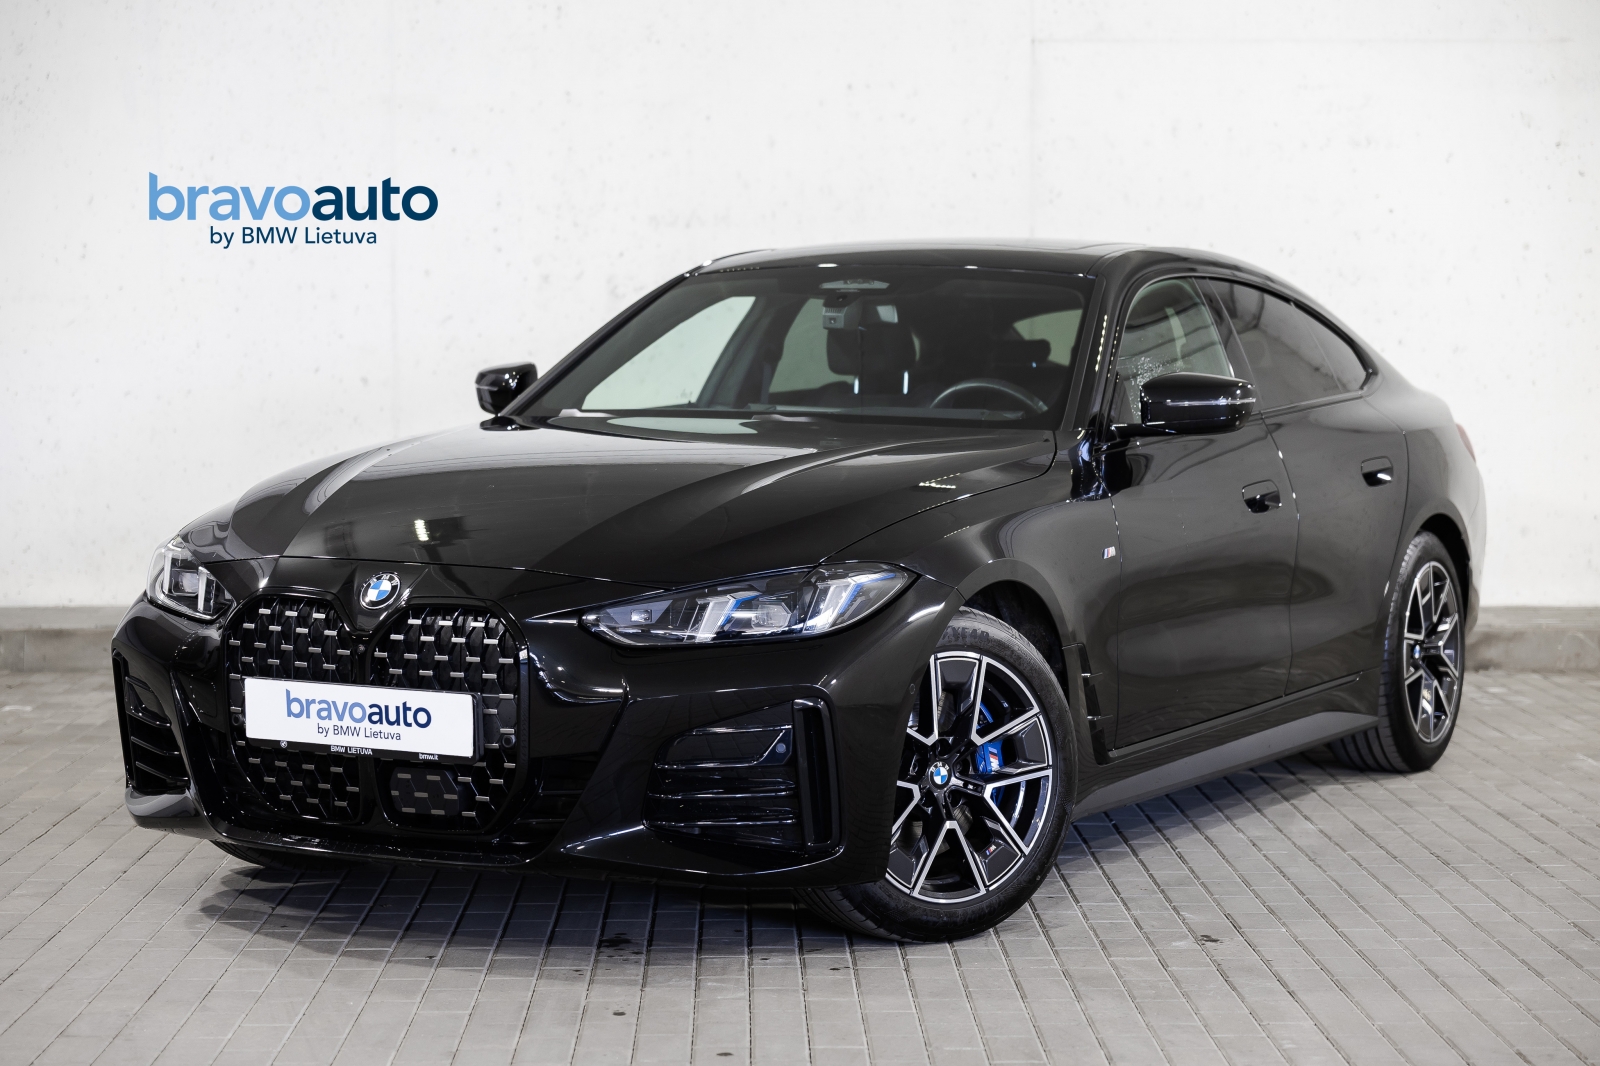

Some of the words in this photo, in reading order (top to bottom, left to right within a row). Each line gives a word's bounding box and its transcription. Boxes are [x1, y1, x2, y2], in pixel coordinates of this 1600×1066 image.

[286, 689, 432, 729] bravoauto
[317, 723, 330, 737] by
[333, 725, 361, 738] BMW
[364, 727, 401, 741] Lietuva
[348, 747, 372, 755] LIETUVA
